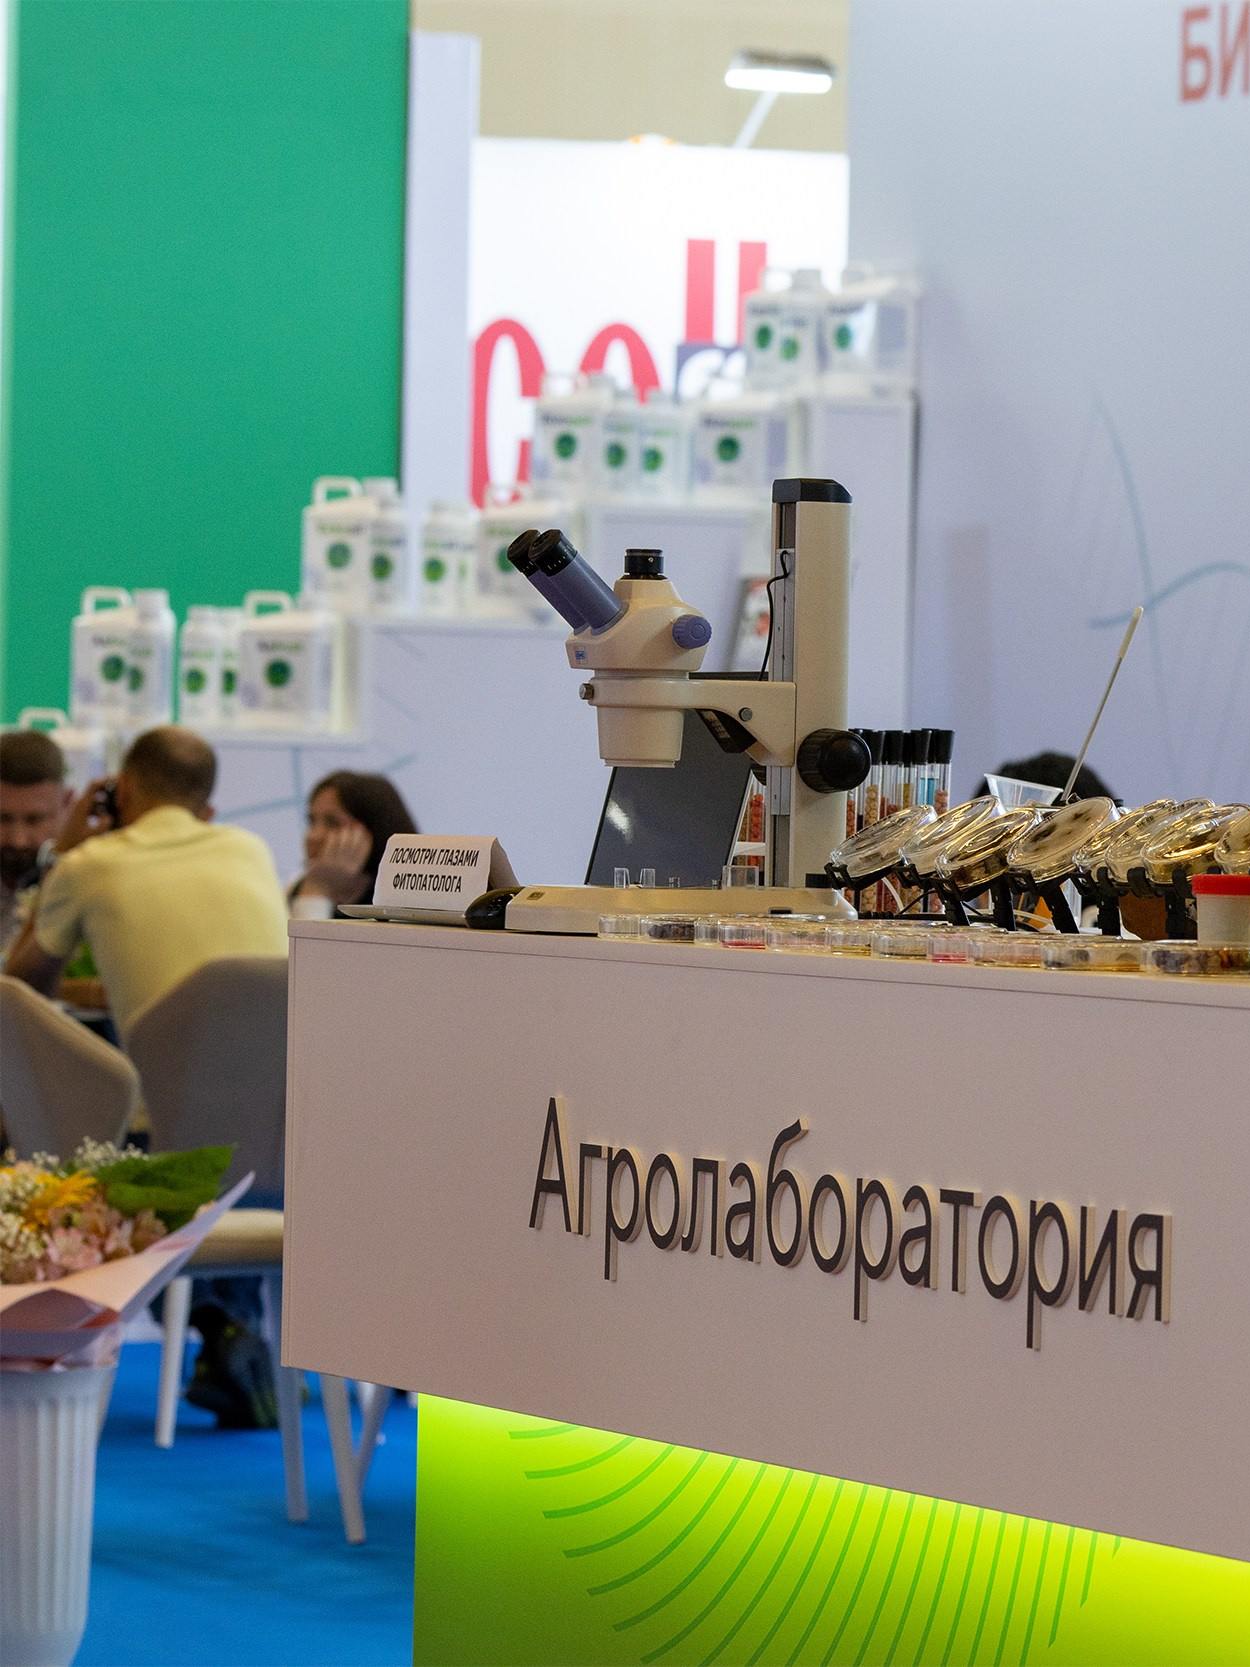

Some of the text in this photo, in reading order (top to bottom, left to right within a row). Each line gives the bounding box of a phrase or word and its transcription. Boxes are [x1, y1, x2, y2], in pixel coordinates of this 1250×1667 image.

[390, 848, 480, 867] ПОСМОТРИ ГЛАЗАМИ
[392, 873, 462, 893] ФИТОПАТОЛОГА
[529, 1096, 1172, 1351] Агролаборатория
